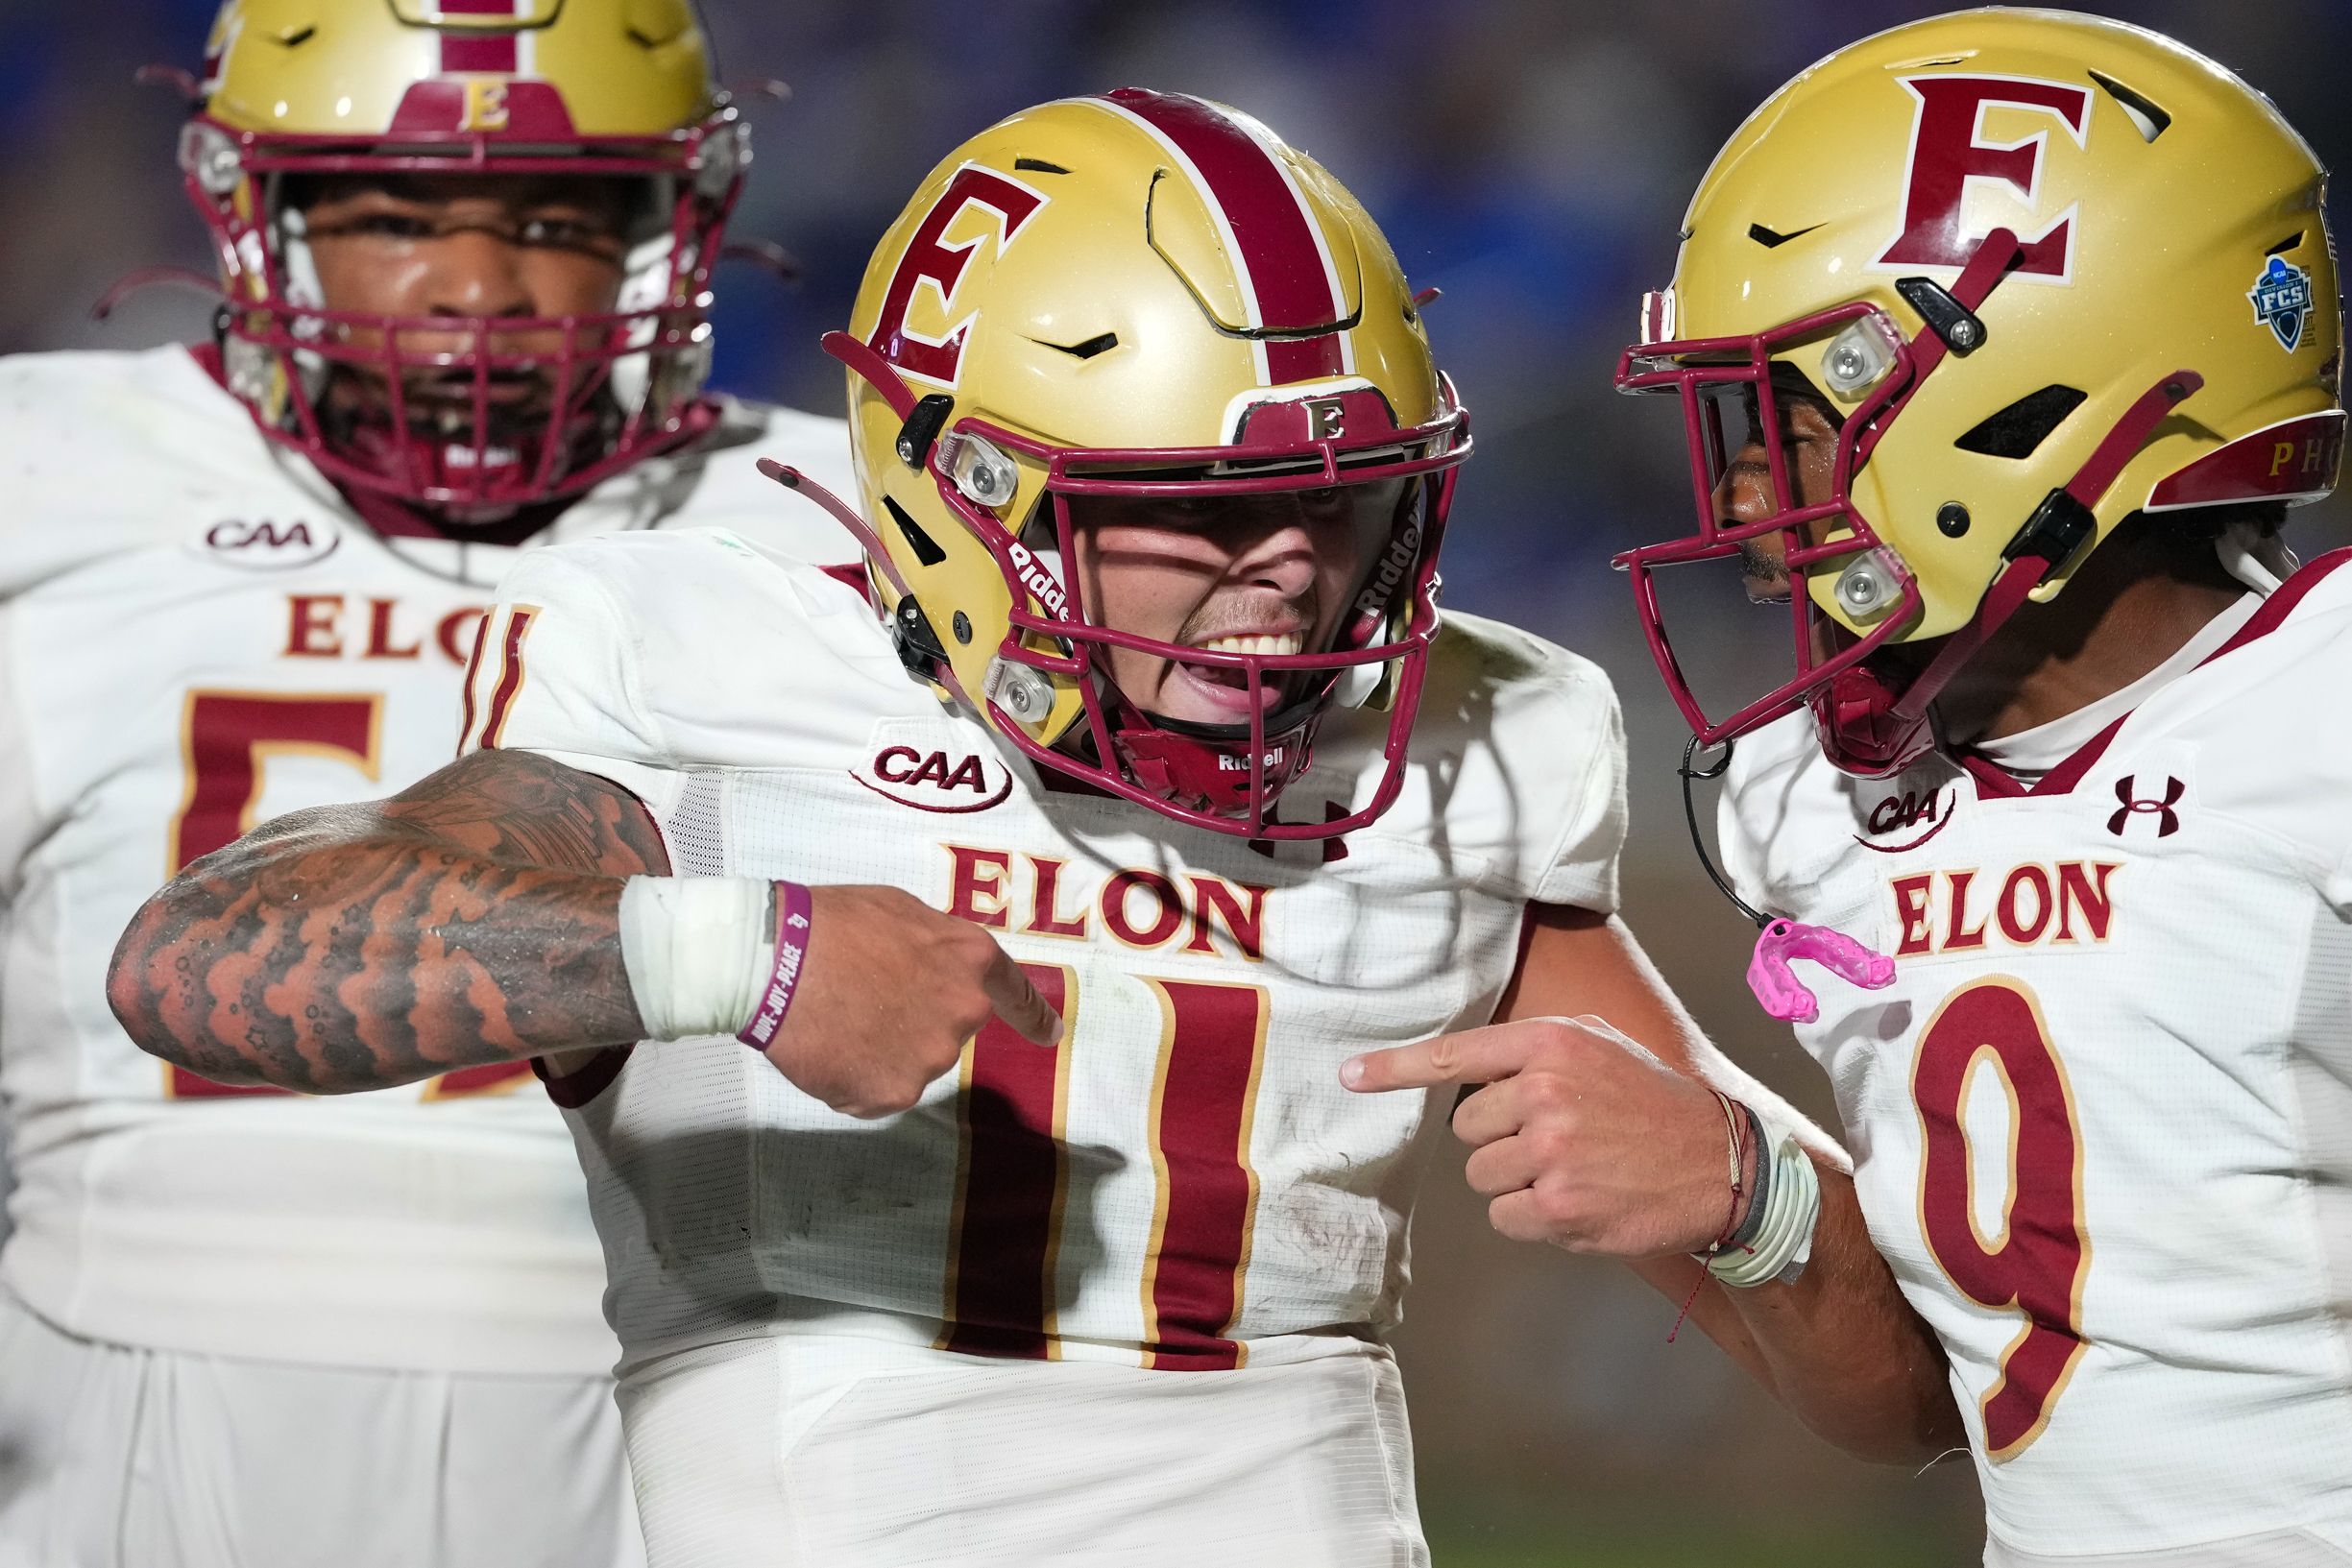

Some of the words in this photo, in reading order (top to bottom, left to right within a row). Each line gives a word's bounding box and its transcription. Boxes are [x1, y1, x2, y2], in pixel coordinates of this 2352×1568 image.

[1864, 73, 2096, 284] E
[867, 162, 1051, 391] E
[2262, 285, 2303, 312] FCS
[206, 519, 311, 548] CAA
[873, 745, 986, 793] CAA
[1219, 747, 1283, 771] Ridell
[1868, 788, 1939, 834] CAA
[939, 843, 1275, 963] ELON
[1888, 860, 2126, 959] ELON
[932, 958, 1272, 1371] 11
[1909, 973, 2092, 1464] 9
